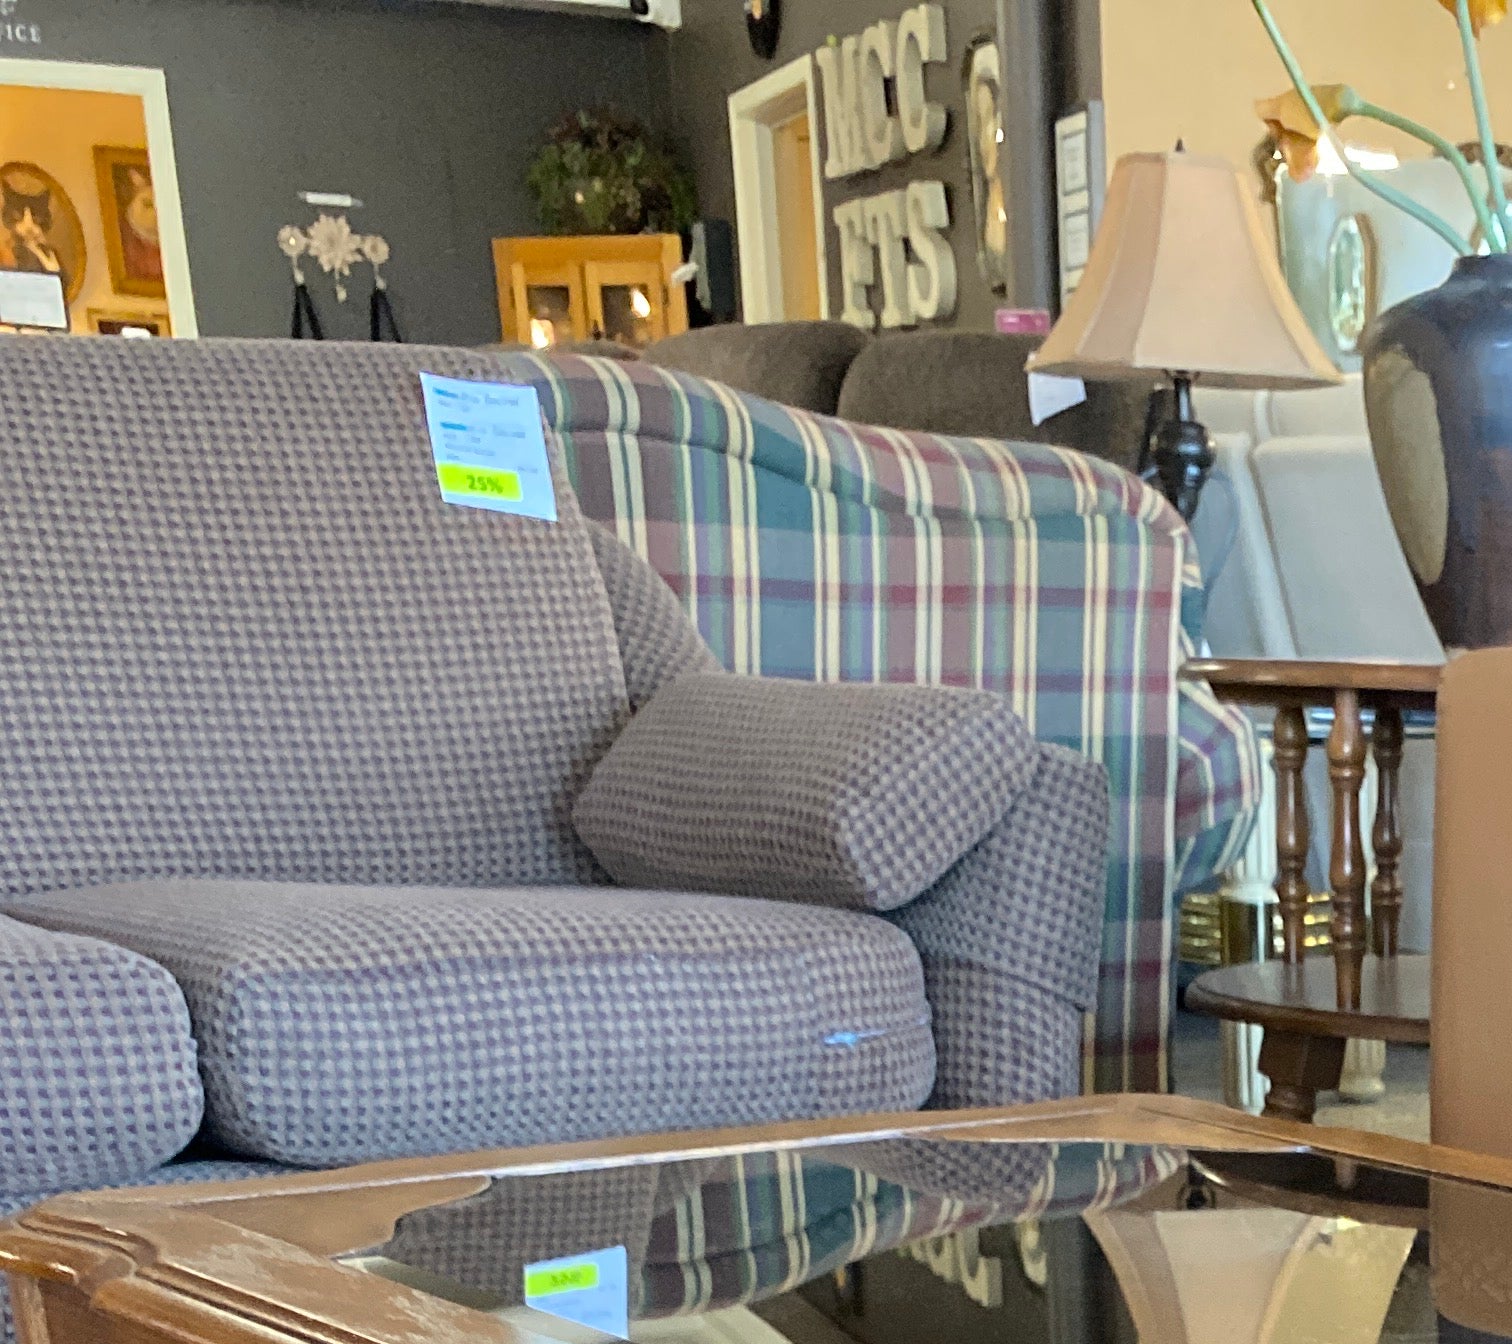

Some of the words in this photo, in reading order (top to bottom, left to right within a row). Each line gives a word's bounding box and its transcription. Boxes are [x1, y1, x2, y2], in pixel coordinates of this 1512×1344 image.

[0, 23, 41, 44] ICE
[816, 4, 947, 179] MCC
[833, 181, 957, 328] FTS
[467, 475, 503, 493] 25%
